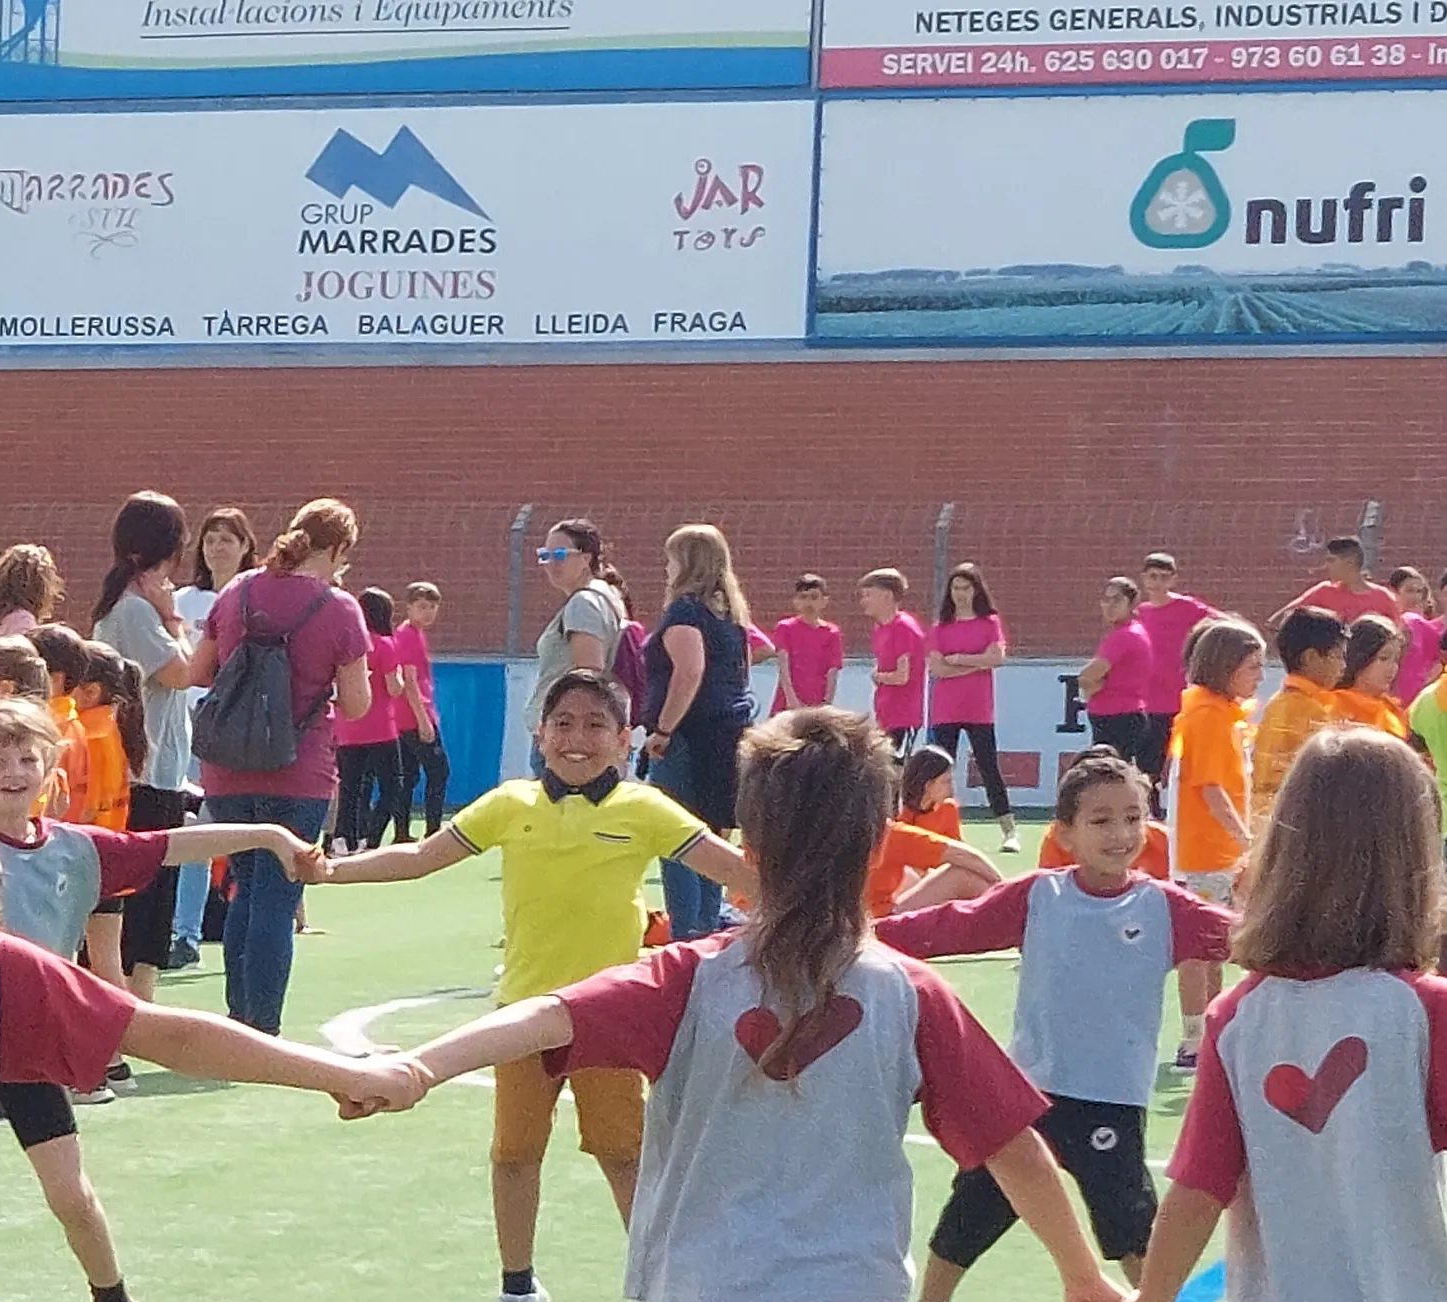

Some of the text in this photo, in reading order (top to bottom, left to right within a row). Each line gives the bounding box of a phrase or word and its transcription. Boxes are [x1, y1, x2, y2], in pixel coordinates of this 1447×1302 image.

[915, 9, 1040, 34] NETEGES
[1049, 6, 1205, 32] GENERALS,
[1215, 2, 1402, 27] INDUSTRIALS
[1412, 1, 1419, 24] I
[882, 52, 974, 76] SERVEI
[980, 50, 1037, 75] 24h.
[1044, 49, 1095, 73] 625
[1102, 48, 1153, 72] 630
[1160, 48, 1208, 70] 017
[1231, 46, 1281, 69] 973
[1288, 45, 1323, 67] 60
[1330, 43, 1364, 67] 61
[1371, 43, 1406, 66] 38
[301, 203, 373, 225] GRUP
[1246, 175, 1427, 244] nufri
[298, 228, 496, 254] MARRADES
[673, 226, 766, 251] TOYS
[295, 270, 496, 302] JOGUINES
[0, 316, 174, 337] MOLLERUSSA
[358, 314, 504, 335] BALAGUER
[535, 313, 629, 334] LLEIDA
[653, 311, 747, 333] FRAGA
